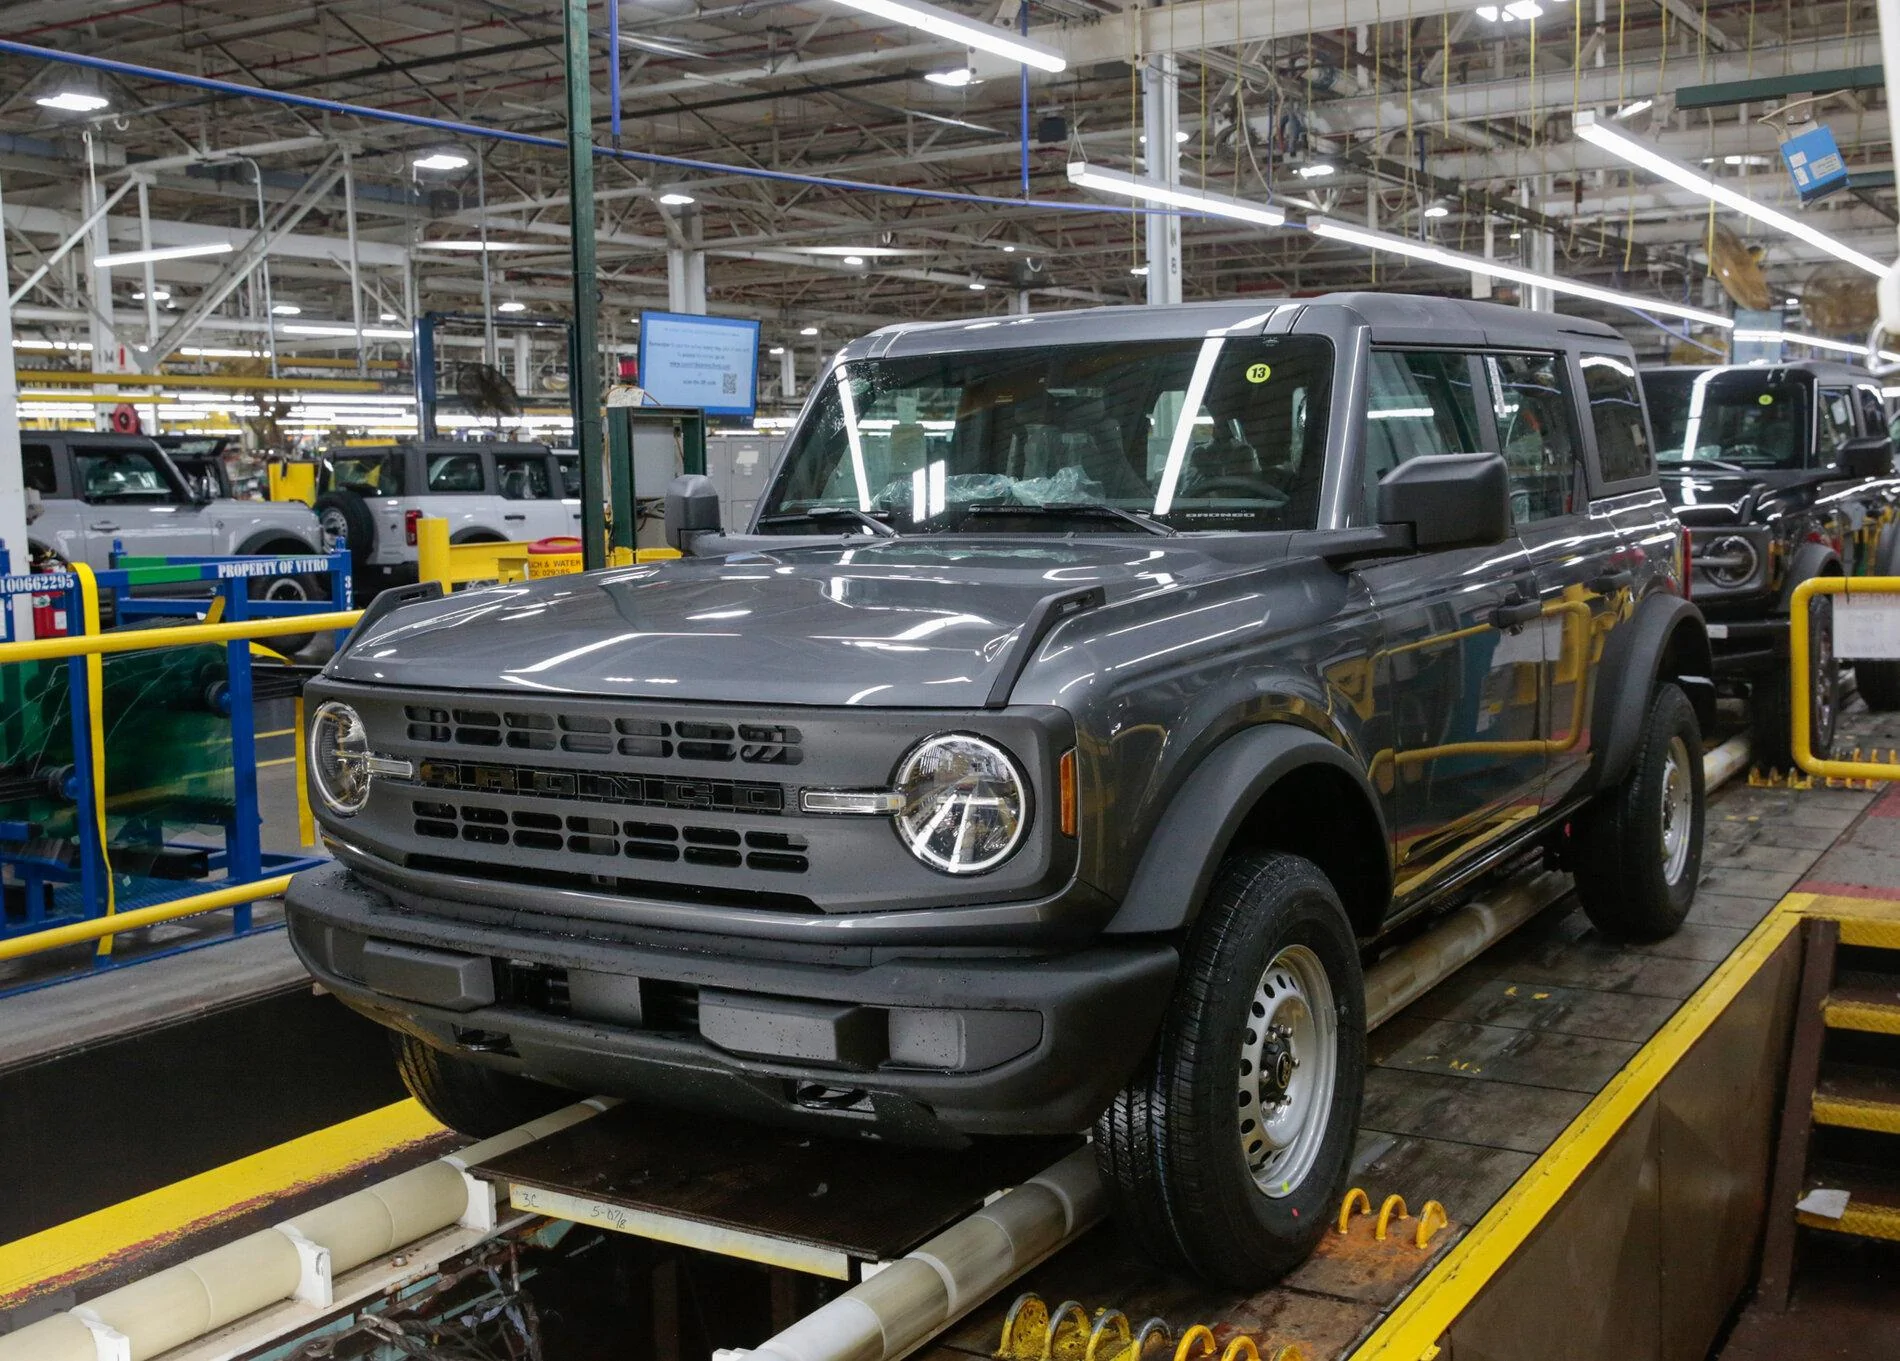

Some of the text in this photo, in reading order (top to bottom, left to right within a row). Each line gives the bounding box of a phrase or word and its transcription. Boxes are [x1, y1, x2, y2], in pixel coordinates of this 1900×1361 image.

[1252, 367, 1266, 378] 13
[218, 558, 329, 579] PROPERTY OF VITRO
[0, 574, 74, 593] 100662295
